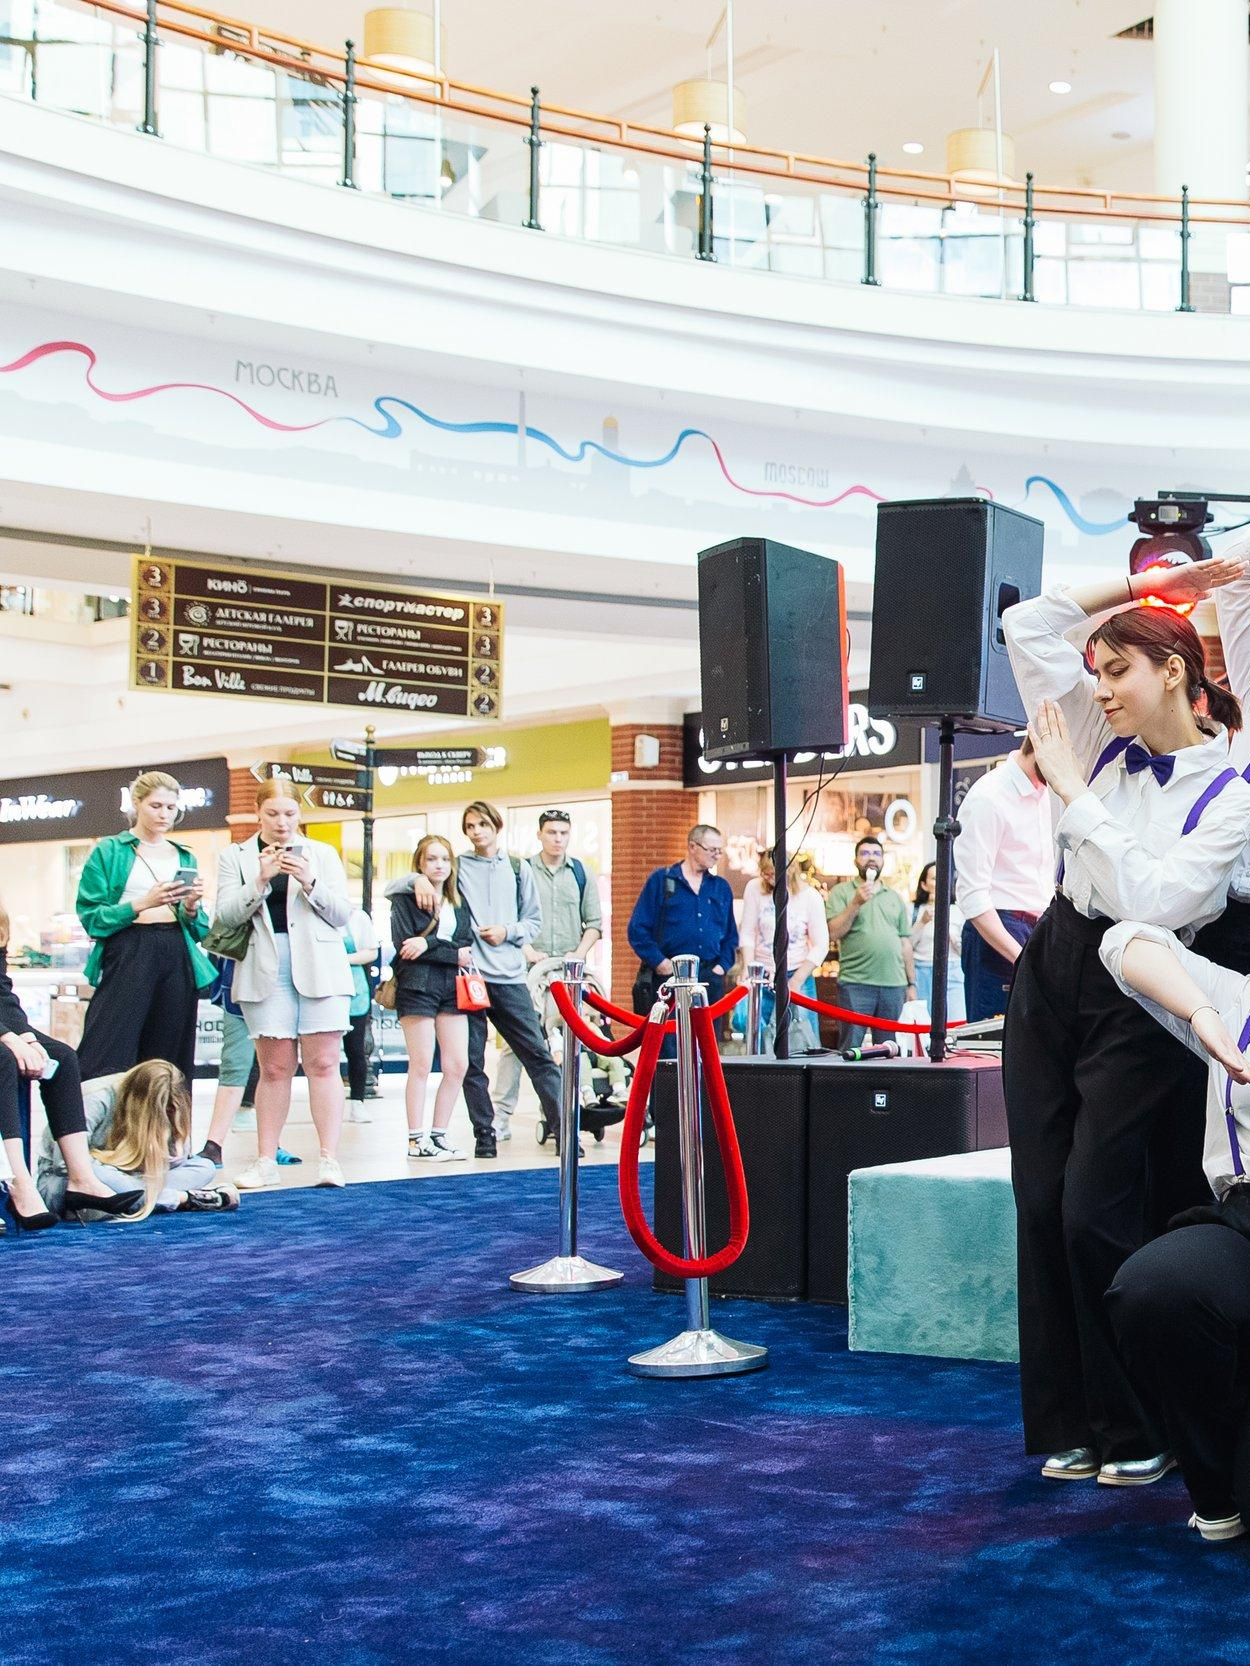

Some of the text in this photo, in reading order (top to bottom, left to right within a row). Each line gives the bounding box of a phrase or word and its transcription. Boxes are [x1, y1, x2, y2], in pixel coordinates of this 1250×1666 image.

[235, 359, 338, 398] МОСКВА
[764, 461, 829, 488] MOSCOW
[149, 565, 161, 583] 3
[148, 598, 160, 615] 3
[481, 607, 492, 623] 3
[215, 607, 266, 624] ДЕТСКАЯ
[268, 612, 314, 628] ГАЛЕРЕЯ
[147, 630, 159, 646] 2
[356, 623, 421, 640] РЕСТОРАНЫ
[202, 636, 273, 654] РЕСТОРАНЫ
[480, 635, 491, 652] 3
[147, 662, 157, 678] 1
[382, 660, 463, 678] ГАЛЕРЕЯ ОБУВИ
[181, 665, 246, 692] Bon Ville
